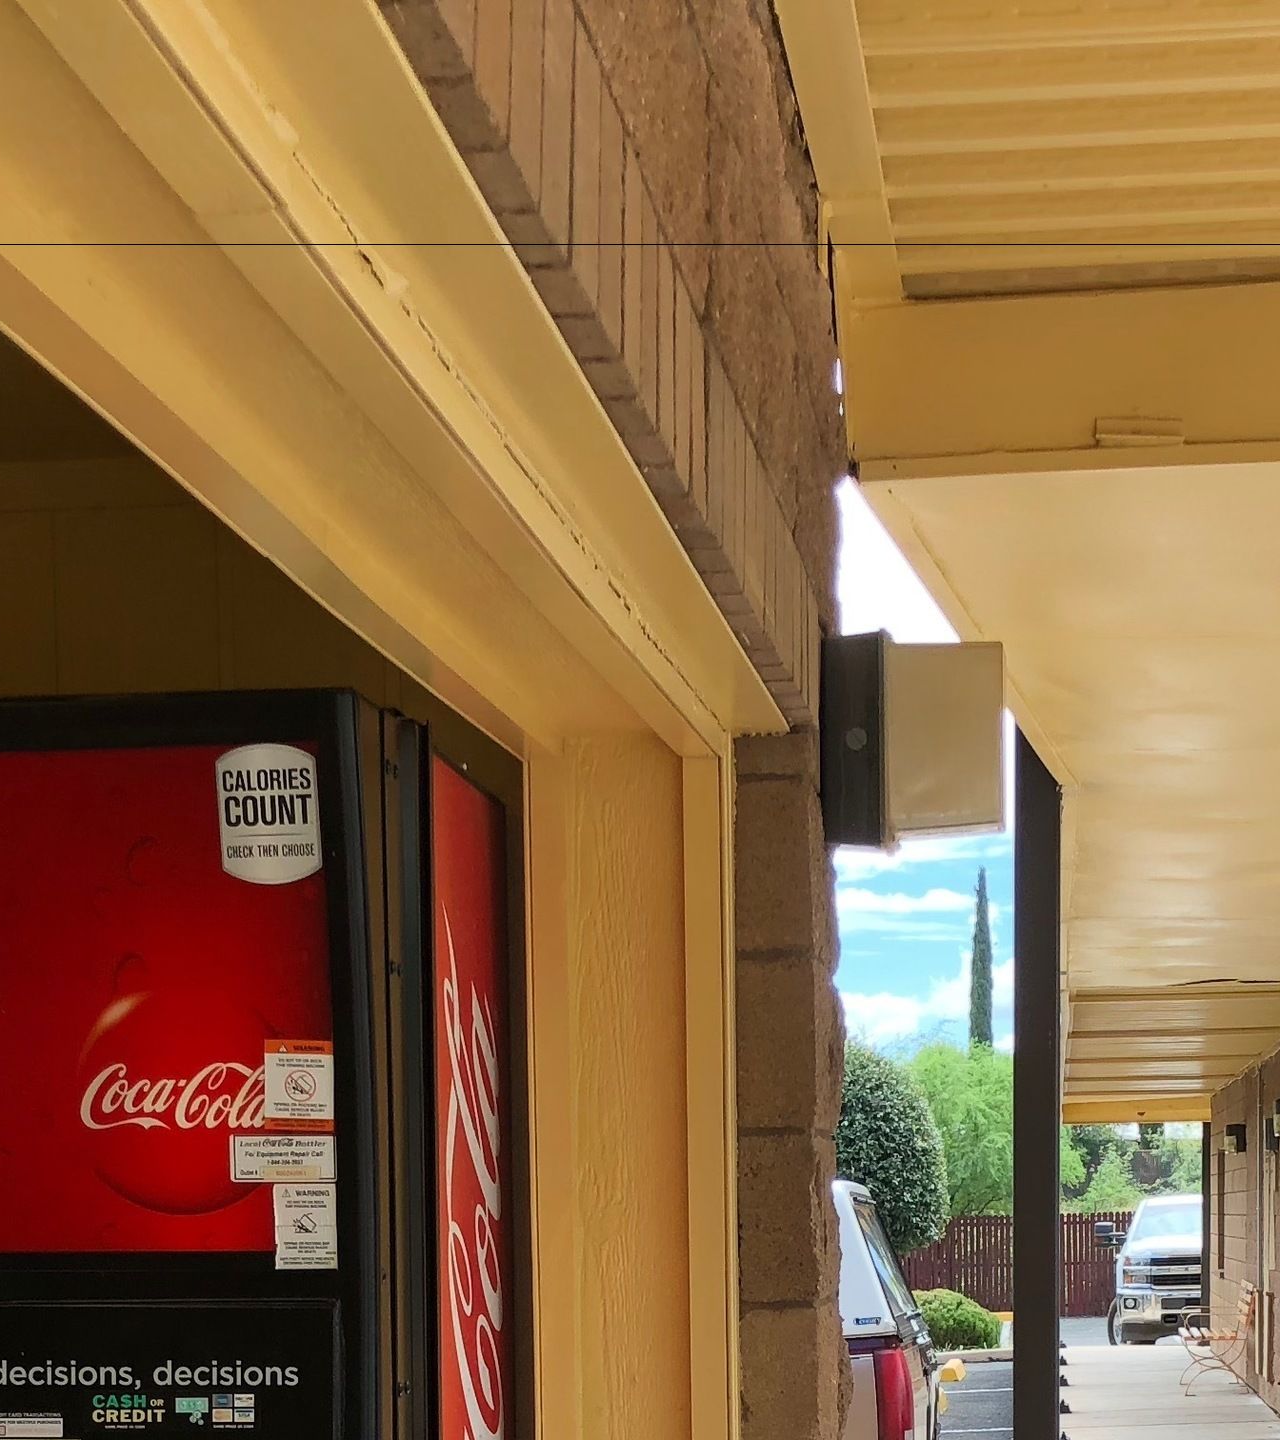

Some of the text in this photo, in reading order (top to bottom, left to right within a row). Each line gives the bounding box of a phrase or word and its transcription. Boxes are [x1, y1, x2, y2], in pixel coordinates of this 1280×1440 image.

[222, 768, 311, 792] CALORIES
[224, 794, 311, 827] COUNT
[226, 843, 315, 859] CHECK THEN CHOOSE
[153, 1360, 298, 1386] decisions
[92, 1394, 164, 1408] CASH OR
[92, 1409, 165, 1423] CREDIT
